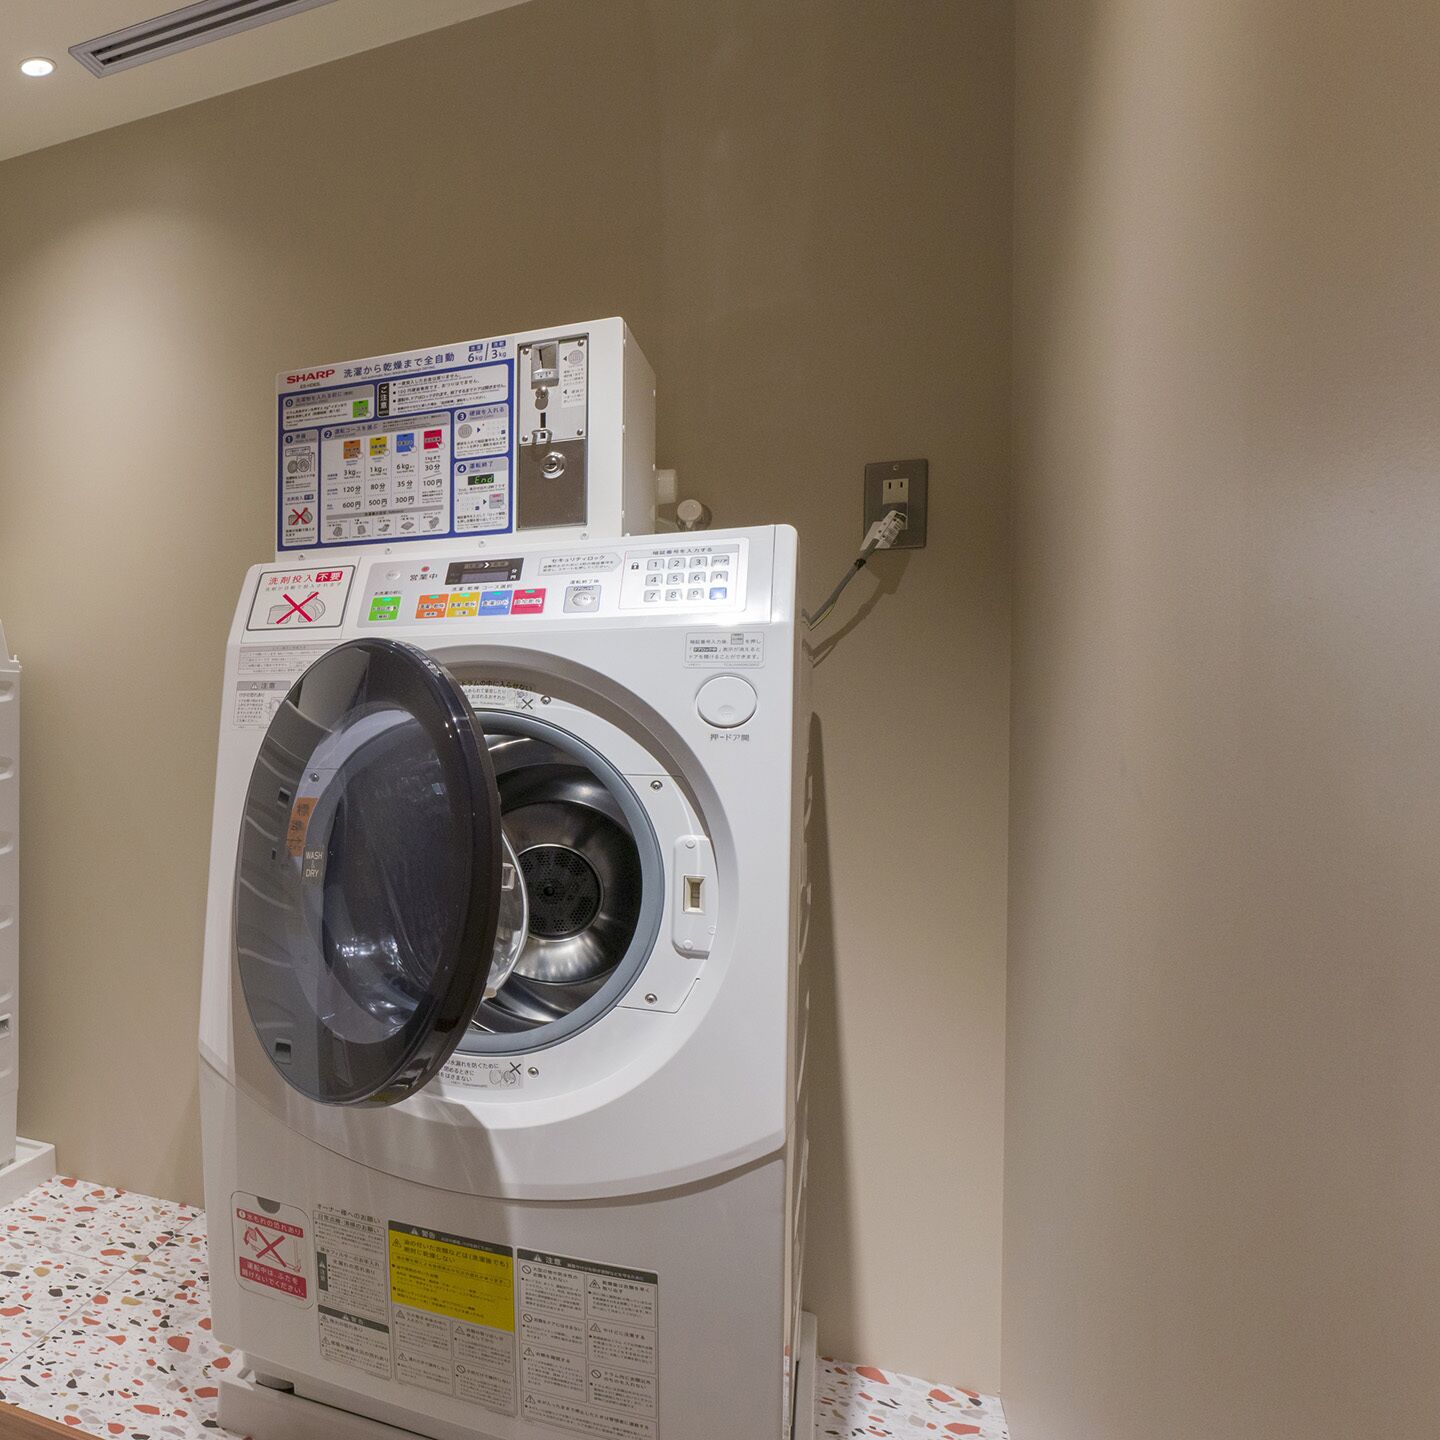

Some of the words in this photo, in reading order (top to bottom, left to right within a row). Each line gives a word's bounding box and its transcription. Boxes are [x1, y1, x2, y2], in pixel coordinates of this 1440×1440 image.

[344, 352, 455, 378] 洗濯から乾燥まで全自動
[286, 369, 335, 384] SHARP
[469, 407, 505, 416] 硬貨を入れる
[424, 463, 440, 471] 30分
[470, 461, 493, 469] 運転終了
[423, 479, 442, 487] 100円
[368, 498, 387, 506] 500円
[395, 496, 414, 504] 300円
[652, 547, 712, 555] 暗証番号を入力する
[552, 555, 606, 563] セキュリティロック
[268, 574, 313, 585] 洗剤投入
[318, 571, 341, 581] 不要
[409, 573, 438, 582] 営業中
[460, 679, 533, 691] ドラムの中に入らせない
[305, 851, 323, 860] WASH
[305, 869, 319, 877] DRY
[246, 1214, 301, 1236] 水もれの恐れあり
[421, 1229, 436, 1240] 警告
[545, 1256, 562, 1266] 注意
[246, 1263, 298, 1285] 運転中は、ふたを
[241, 1268, 304, 1297] 開けないでください。
